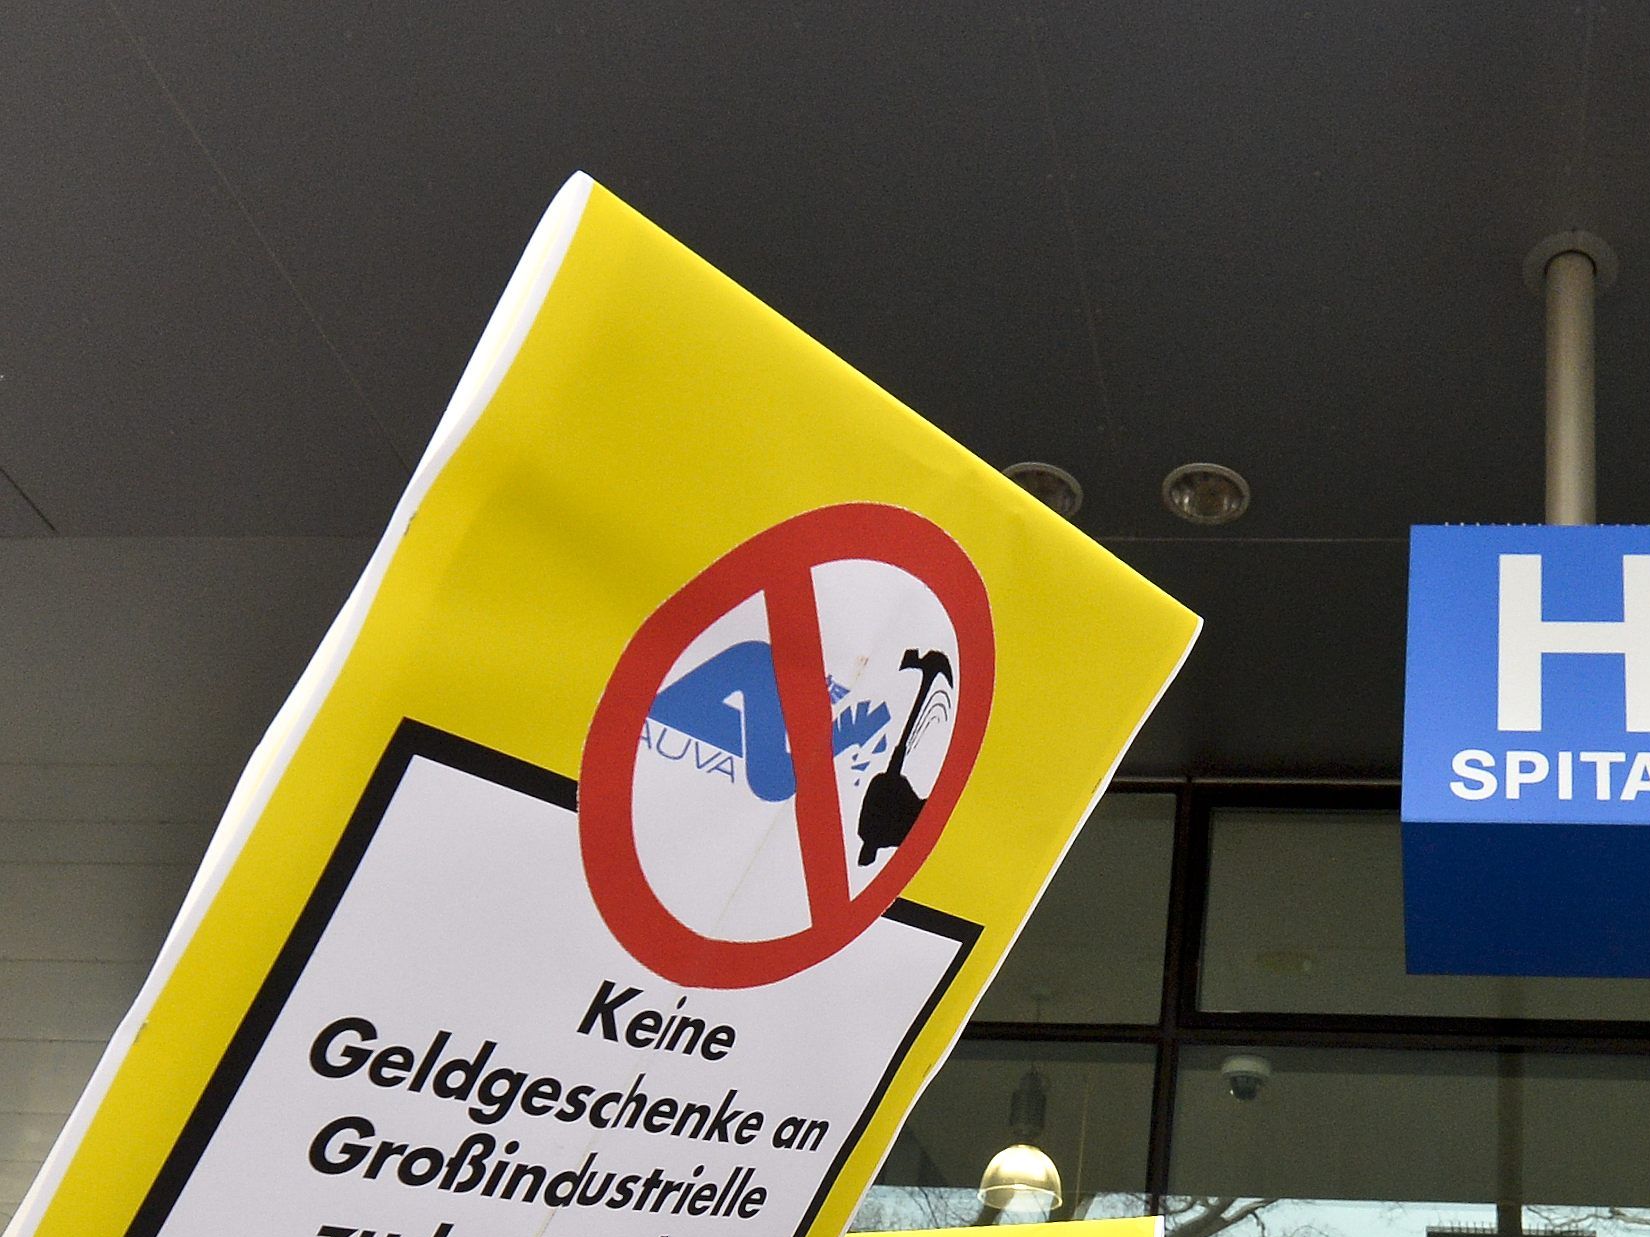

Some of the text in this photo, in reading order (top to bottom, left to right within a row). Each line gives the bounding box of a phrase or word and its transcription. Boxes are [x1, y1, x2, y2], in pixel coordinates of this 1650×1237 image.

[577, 980, 736, 1061] Keine
[309, 1017, 830, 1152] Geldgeschenke an
[308, 1116, 767, 1219] Großindustrielle
